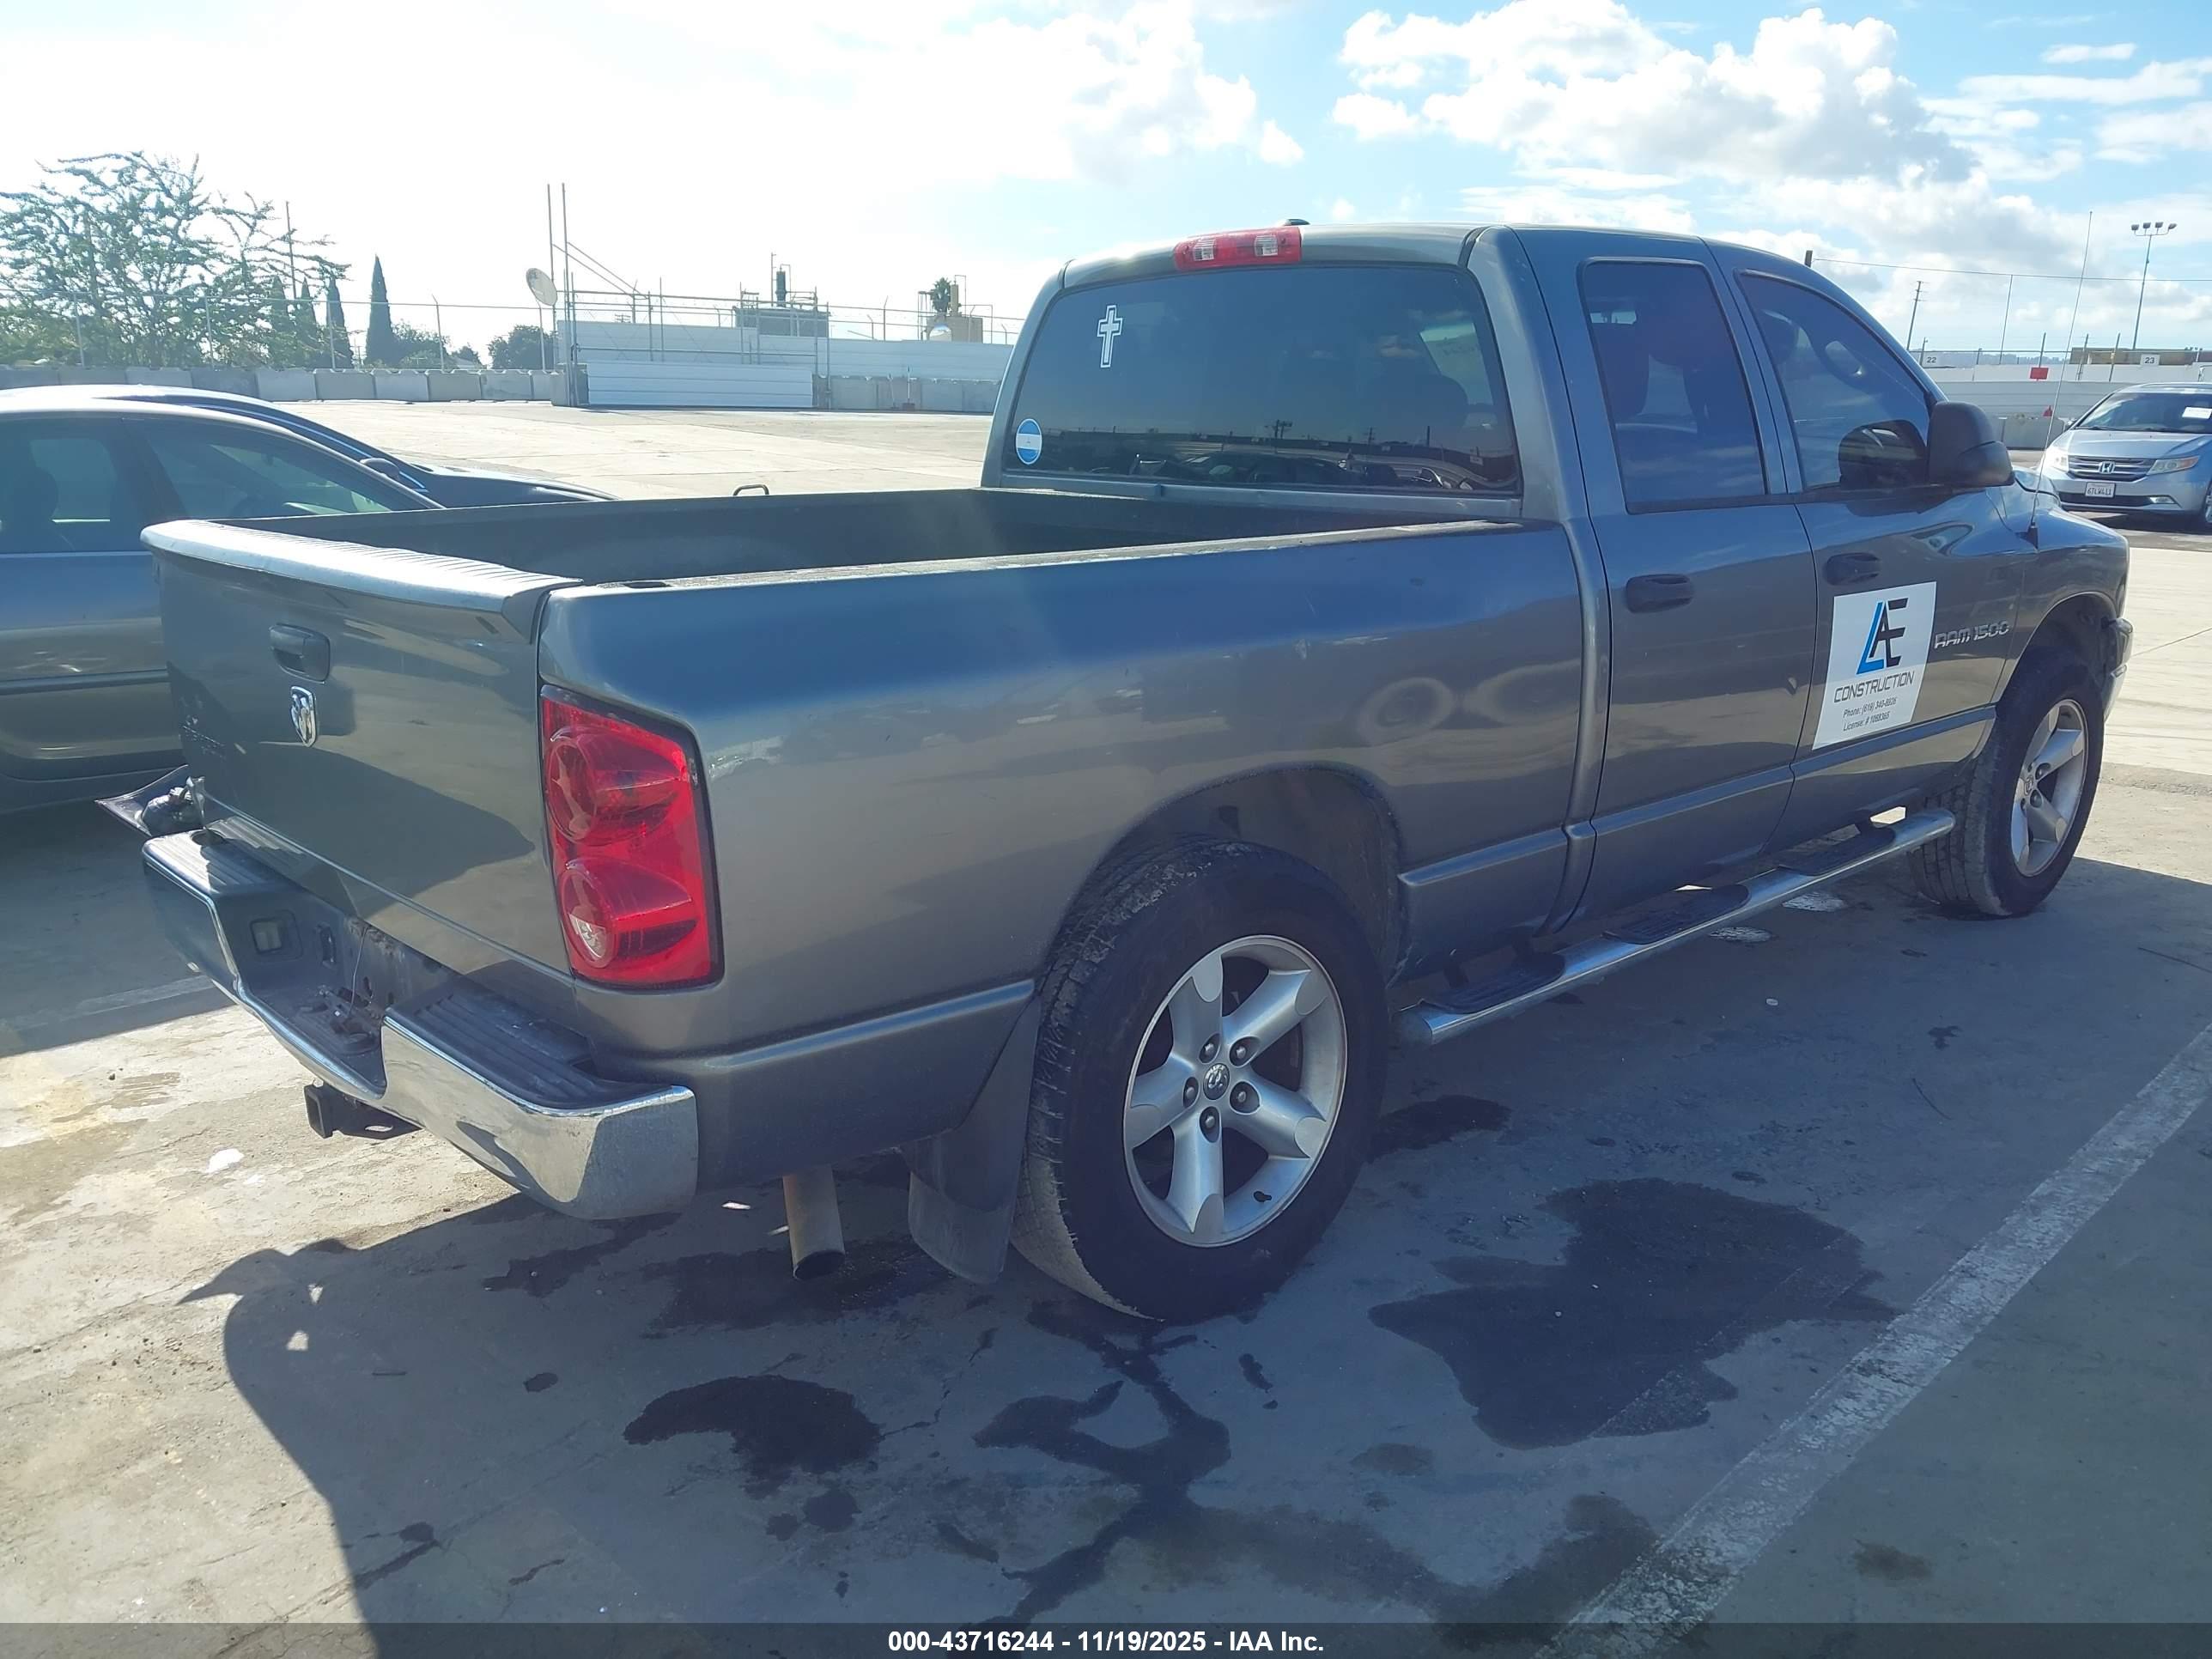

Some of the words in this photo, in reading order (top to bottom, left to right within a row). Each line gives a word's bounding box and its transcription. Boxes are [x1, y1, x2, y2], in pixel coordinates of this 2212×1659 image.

[1934, 628, 1972, 649] RAM
[1973, 620, 2010, 641] 1500
[1833, 671, 1915, 703] CONSTRUCTION
[1843, 707, 1863, 718] Phone:
